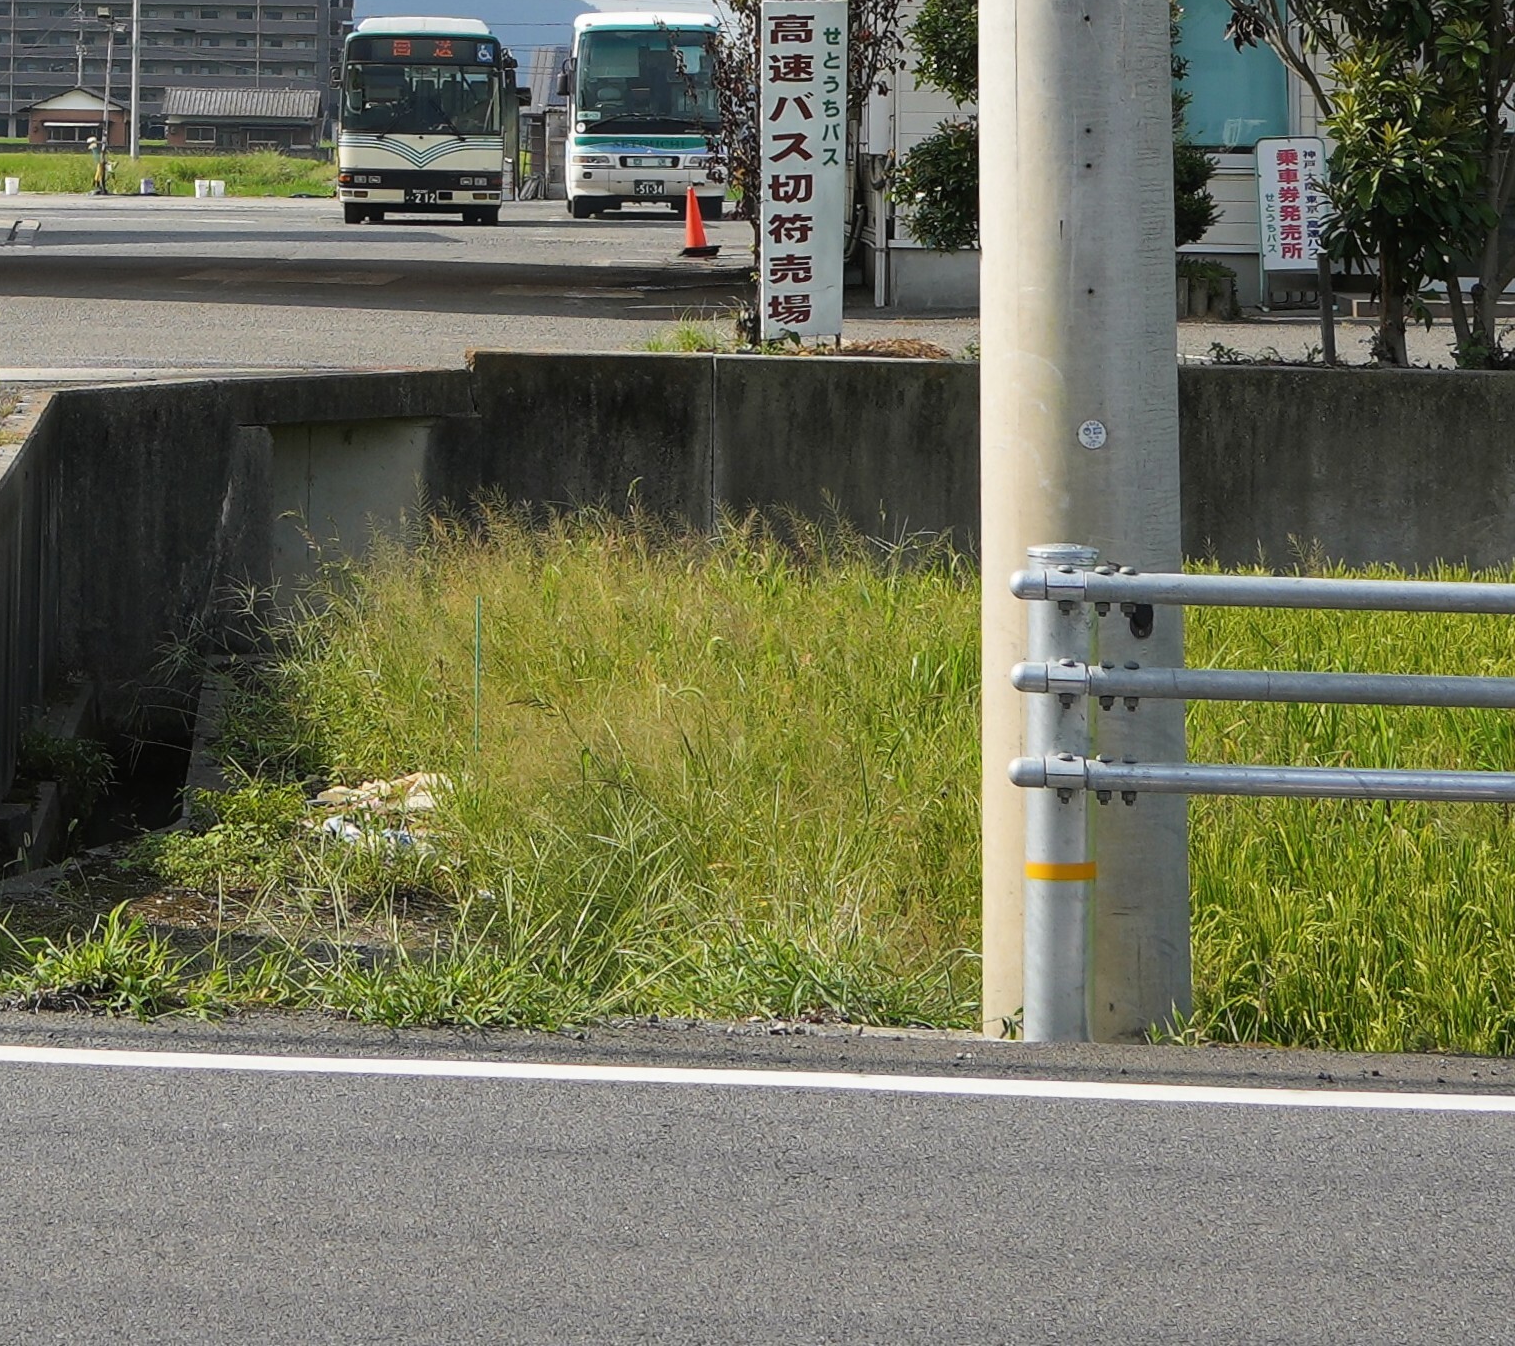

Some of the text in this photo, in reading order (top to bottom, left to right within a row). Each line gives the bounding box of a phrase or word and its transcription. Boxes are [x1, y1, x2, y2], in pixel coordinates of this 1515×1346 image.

[613, 138, 687, 149] SETOUCHI
[821, 26, 842, 167] せとうちバス
[768, 14, 815, 326] 高速バス切符売場
[1265, 193, 1277, 253] せとうちバス
[1276, 148, 1303, 259] 乗車券発売所
